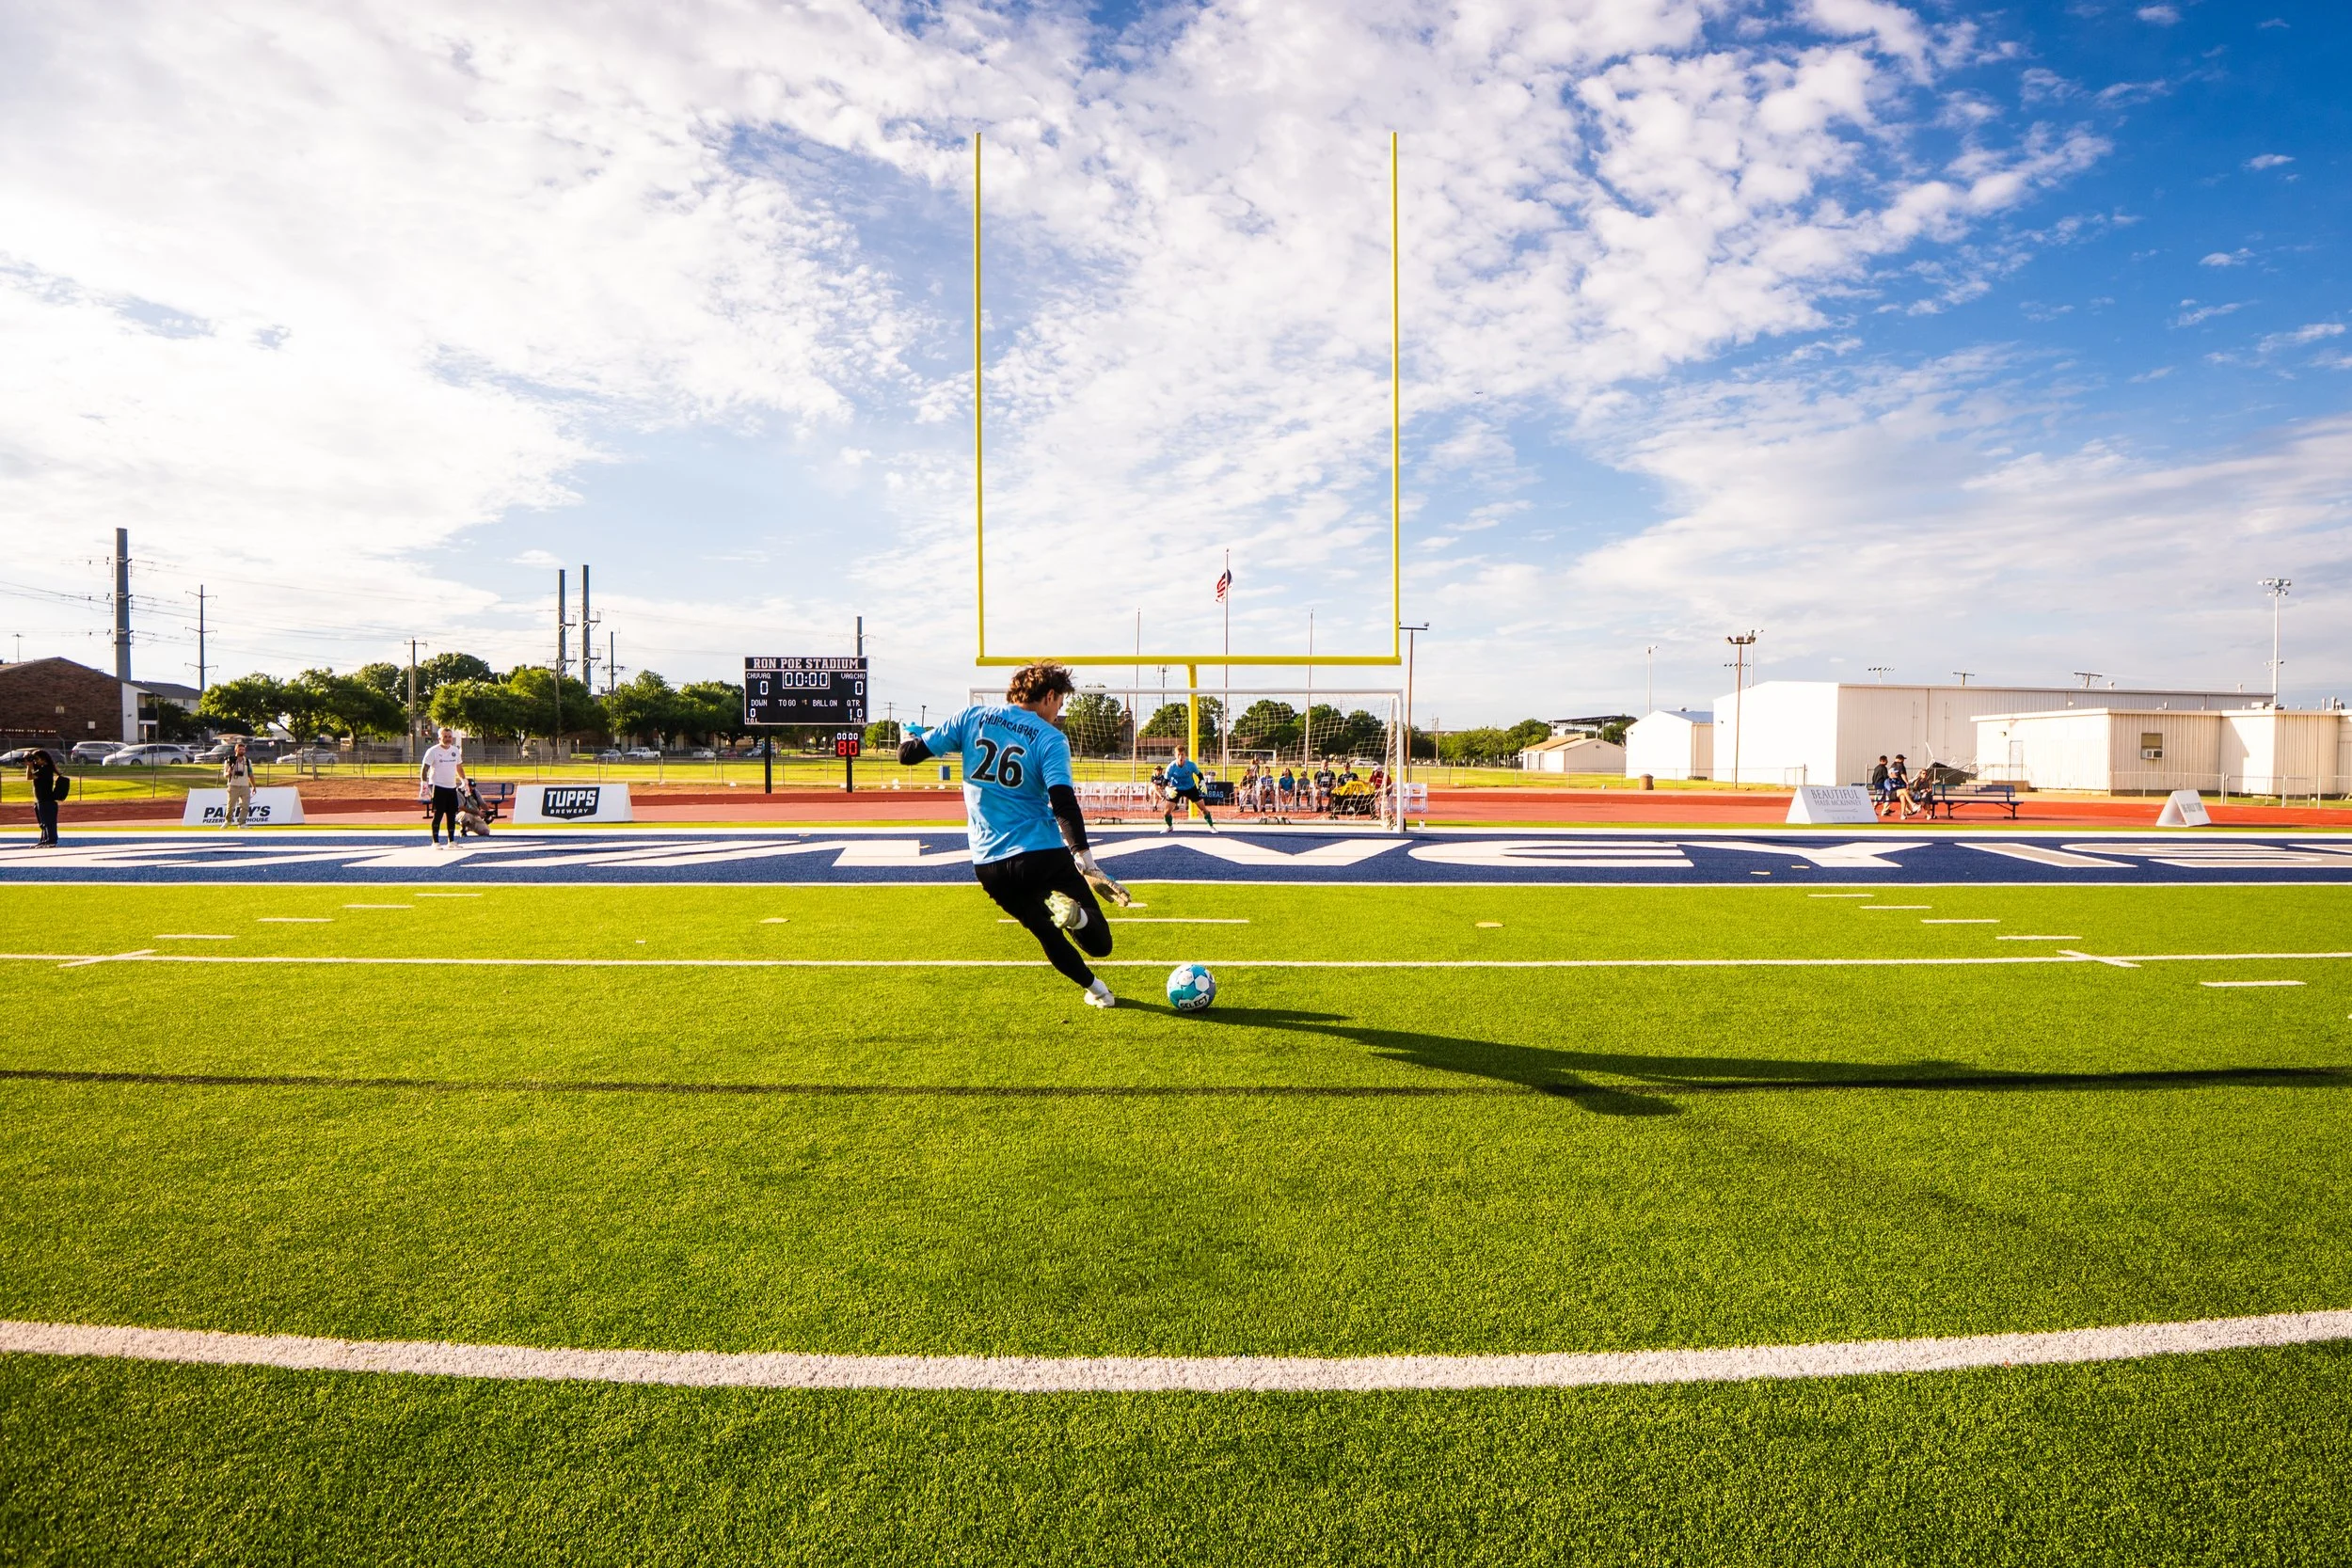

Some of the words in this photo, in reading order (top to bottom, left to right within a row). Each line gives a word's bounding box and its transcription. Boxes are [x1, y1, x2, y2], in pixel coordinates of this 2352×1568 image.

[754, 657, 776, 669] RON
[781, 657, 802, 669] POE
[805, 657, 859, 669] STADIUM
[785, 672, 828, 687] 00:00
[760, 681, 769, 695] 0
[855, 681, 864, 695] 0
[750, 708, 756, 718] 0
[857, 708, 864, 718] 0
[979, 714, 1039, 744] CHUPACABRAS
[838, 740, 857, 755] 80
[970, 737, 1025, 788] 26
[548, 790, 596, 807] TUPPS
[1810, 789, 1860, 800] BEAUTIFUL
[203, 805, 271, 818] PAY'S
[1954, 843, 2352, 868] IS
[1180, 995, 1208, 1008] SELECT
